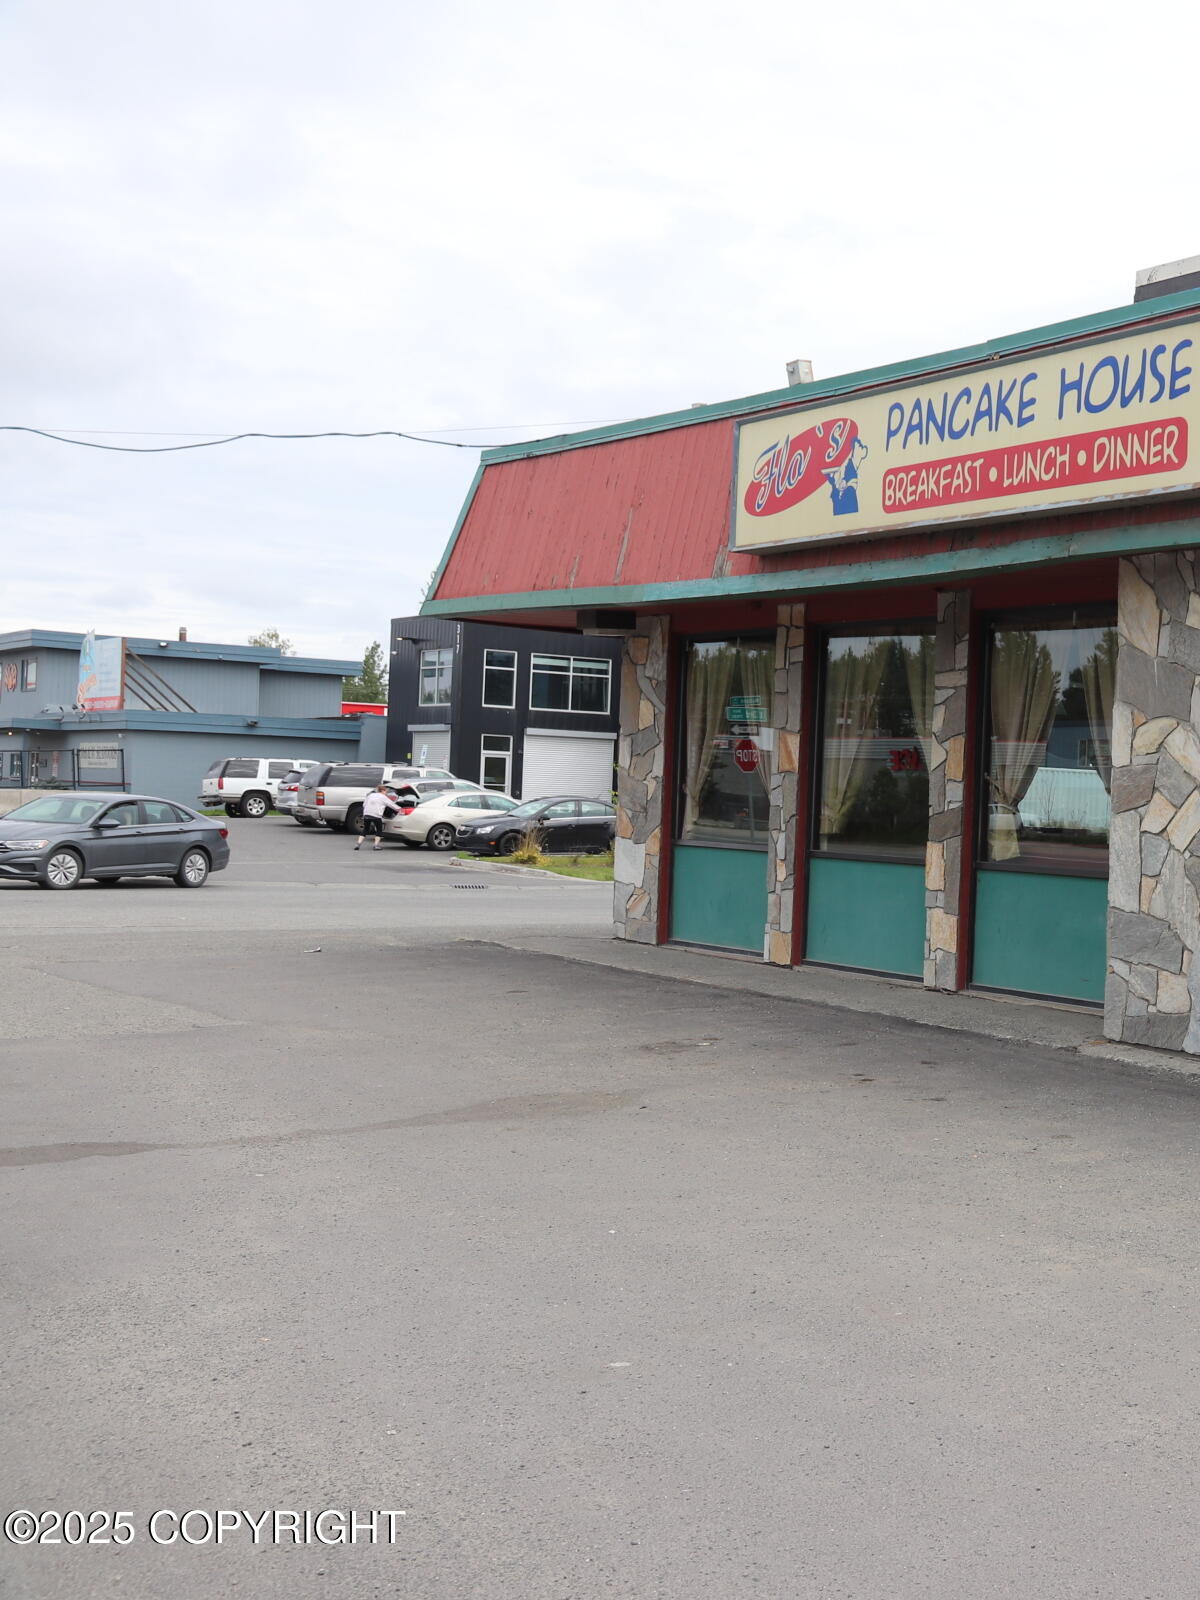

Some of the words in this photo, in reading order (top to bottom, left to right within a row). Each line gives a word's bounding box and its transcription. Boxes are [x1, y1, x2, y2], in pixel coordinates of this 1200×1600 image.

[886, 372, 1039, 452] PANCAKE
[1058, 339, 1193, 420] HOUSE
[753, 419, 852, 511] Flo's
[884, 458, 984, 506] BREAKFAST
[1003, 446, 1070, 485] LUNCH
[1093, 425, 1179, 473] DINNER
